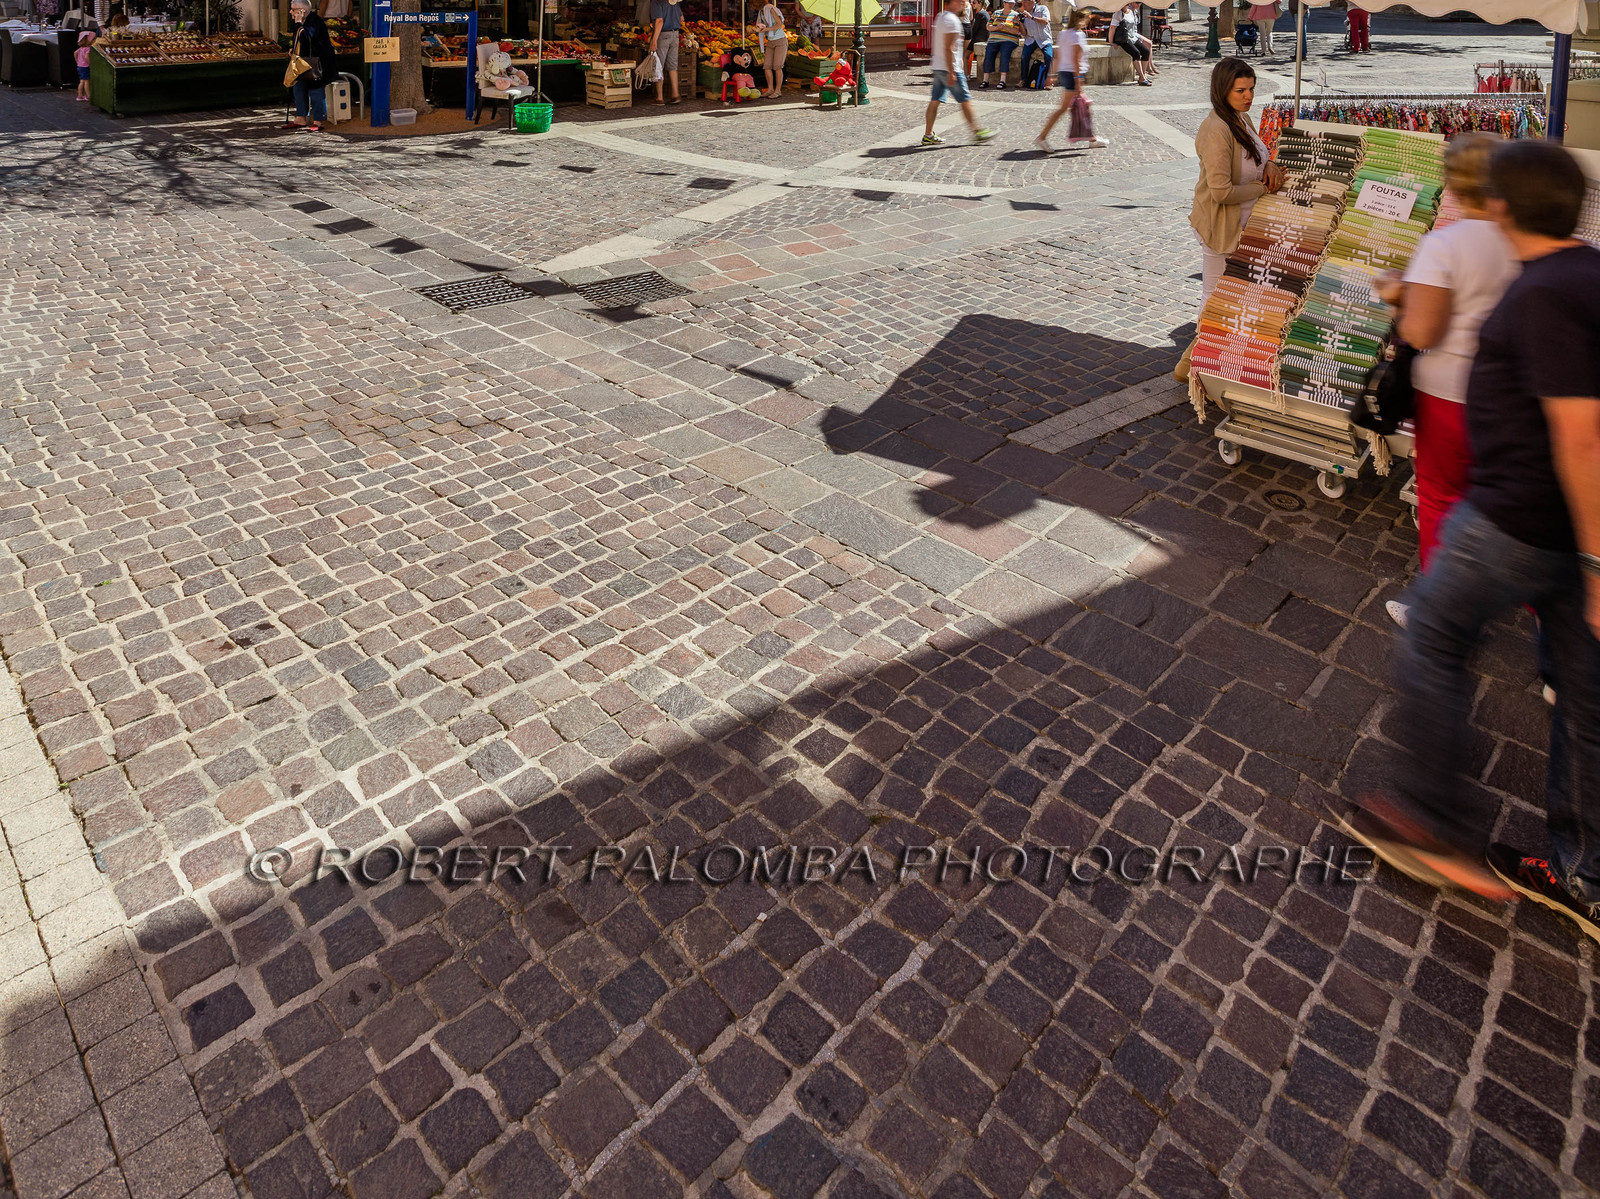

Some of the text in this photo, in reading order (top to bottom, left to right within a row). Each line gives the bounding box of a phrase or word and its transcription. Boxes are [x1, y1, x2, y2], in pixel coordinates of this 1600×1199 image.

[384, 14, 440, 24] Royal Bon Repos
[1370, 184, 1408, 200] FOUTAS
